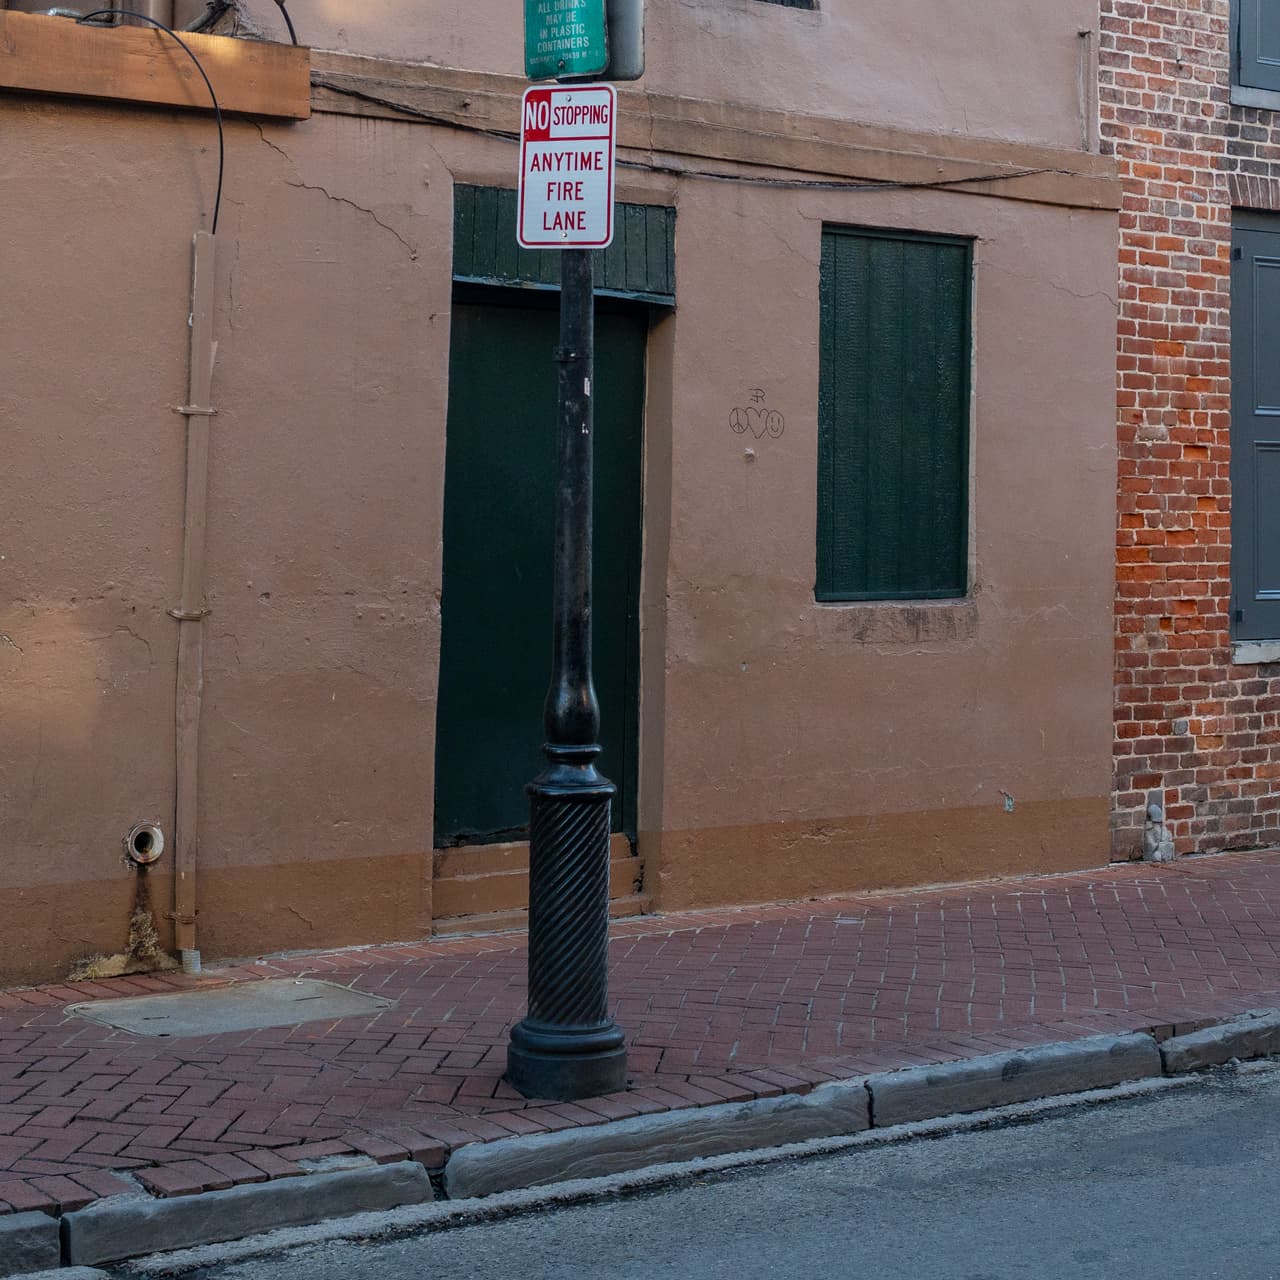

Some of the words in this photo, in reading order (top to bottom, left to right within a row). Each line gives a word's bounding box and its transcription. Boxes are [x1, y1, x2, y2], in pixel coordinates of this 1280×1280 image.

[538, 2, 551, 13] ALL
[546, 14, 562, 25] MAY
[565, 11, 577, 23] BE
[540, 27, 548, 39] IN
[551, 23, 585, 37] PLASTIC
[537, 36, 590, 53] CONTAINERS
[525, 101, 549, 130] NO
[553, 105, 608, 125] STOPPING
[530, 152, 603, 172] ANYTIME
[547, 182, 584, 200] FIRE
[543, 211, 586, 230] LANE
